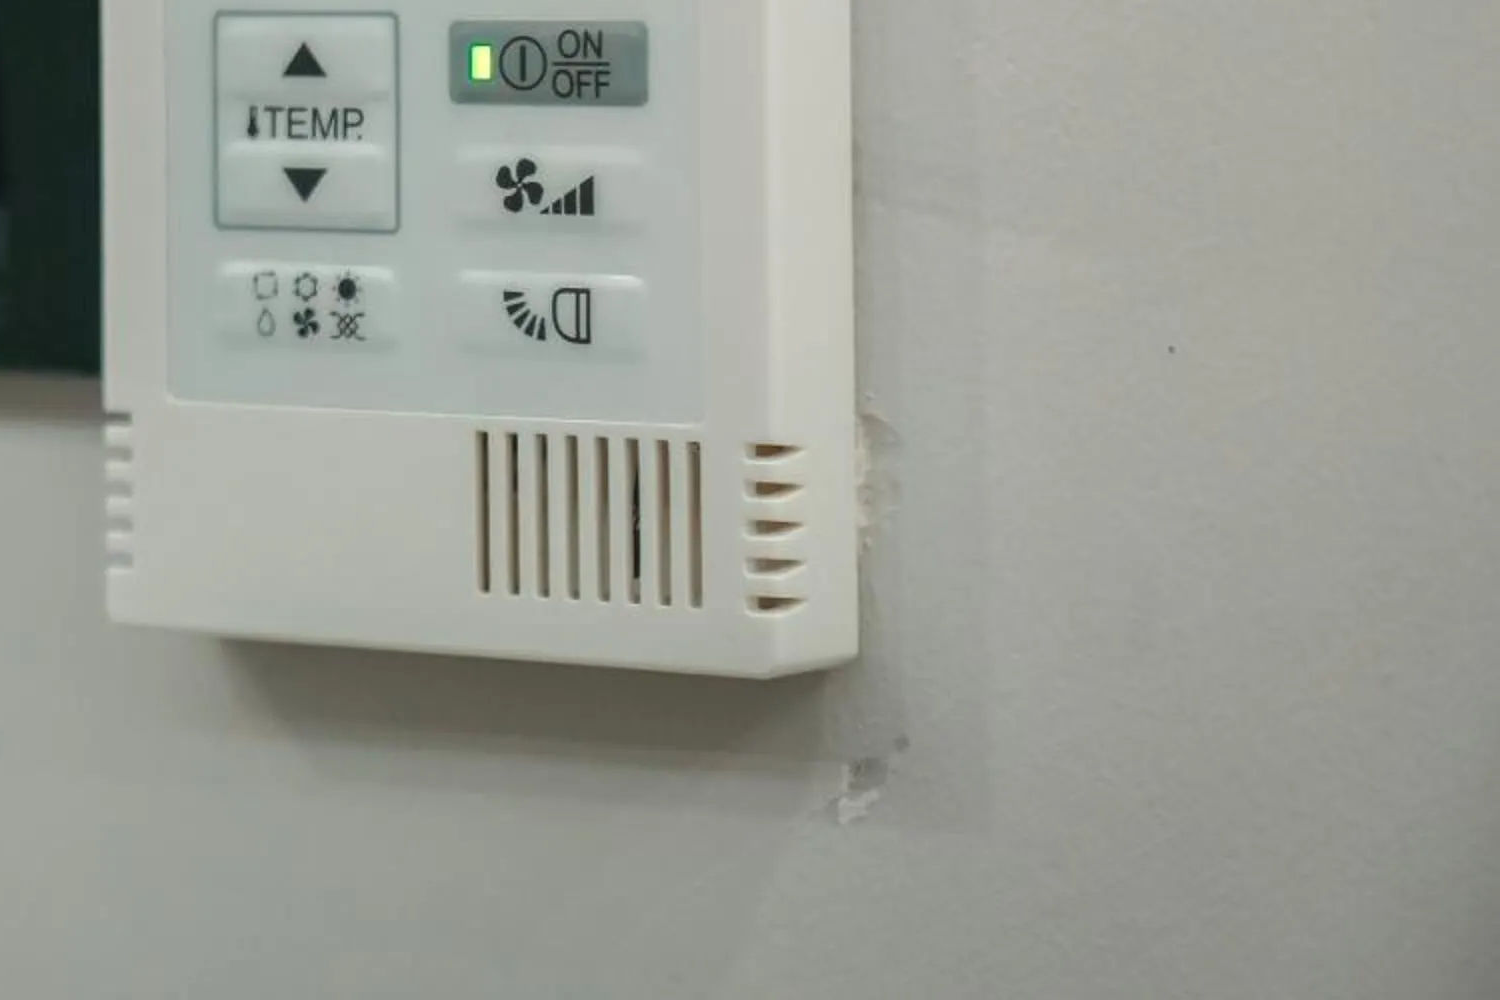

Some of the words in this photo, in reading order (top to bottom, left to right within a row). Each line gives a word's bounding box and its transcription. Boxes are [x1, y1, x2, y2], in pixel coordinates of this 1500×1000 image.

[557, 29, 603, 59] ON
[551, 69, 610, 99] OFF
[264, 106, 364, 141] TEMP.
